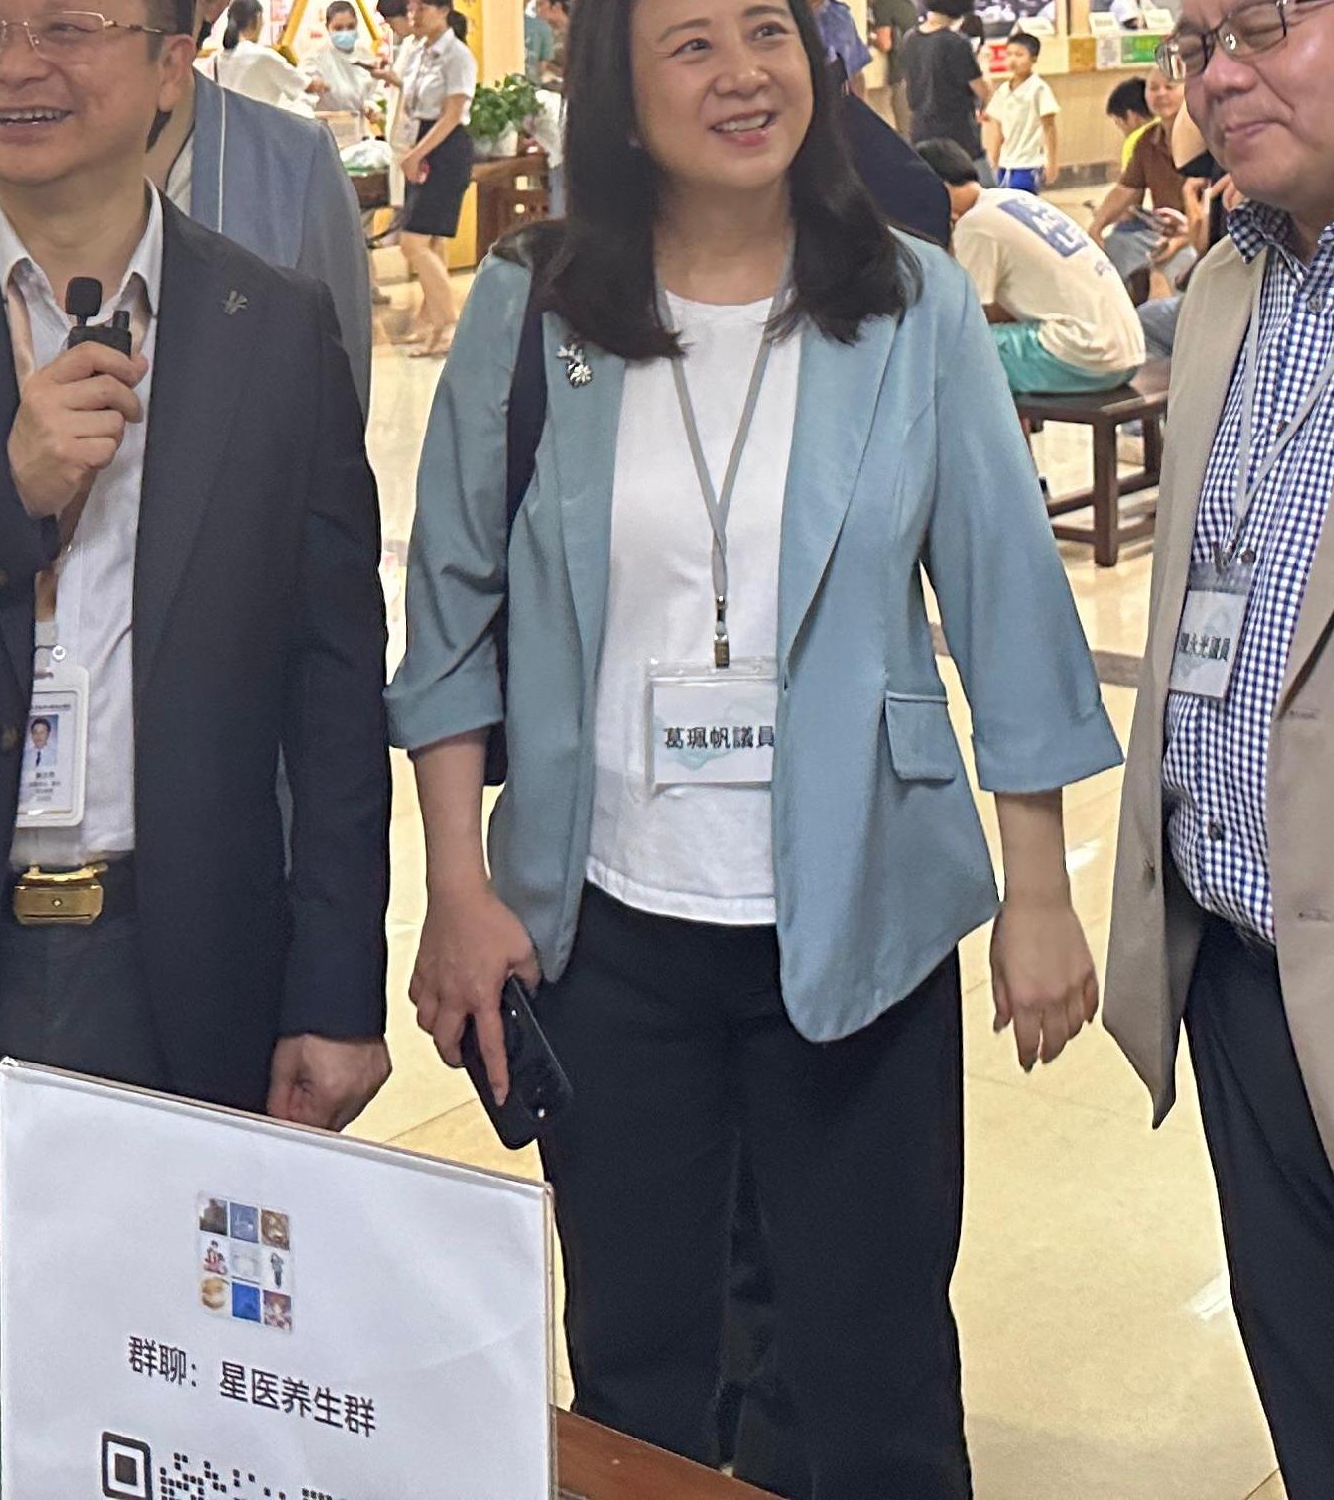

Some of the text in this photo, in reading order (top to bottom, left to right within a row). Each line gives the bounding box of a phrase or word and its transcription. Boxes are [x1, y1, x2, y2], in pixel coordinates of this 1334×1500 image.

[663, 725, 775, 749] 葛珮帆議員
